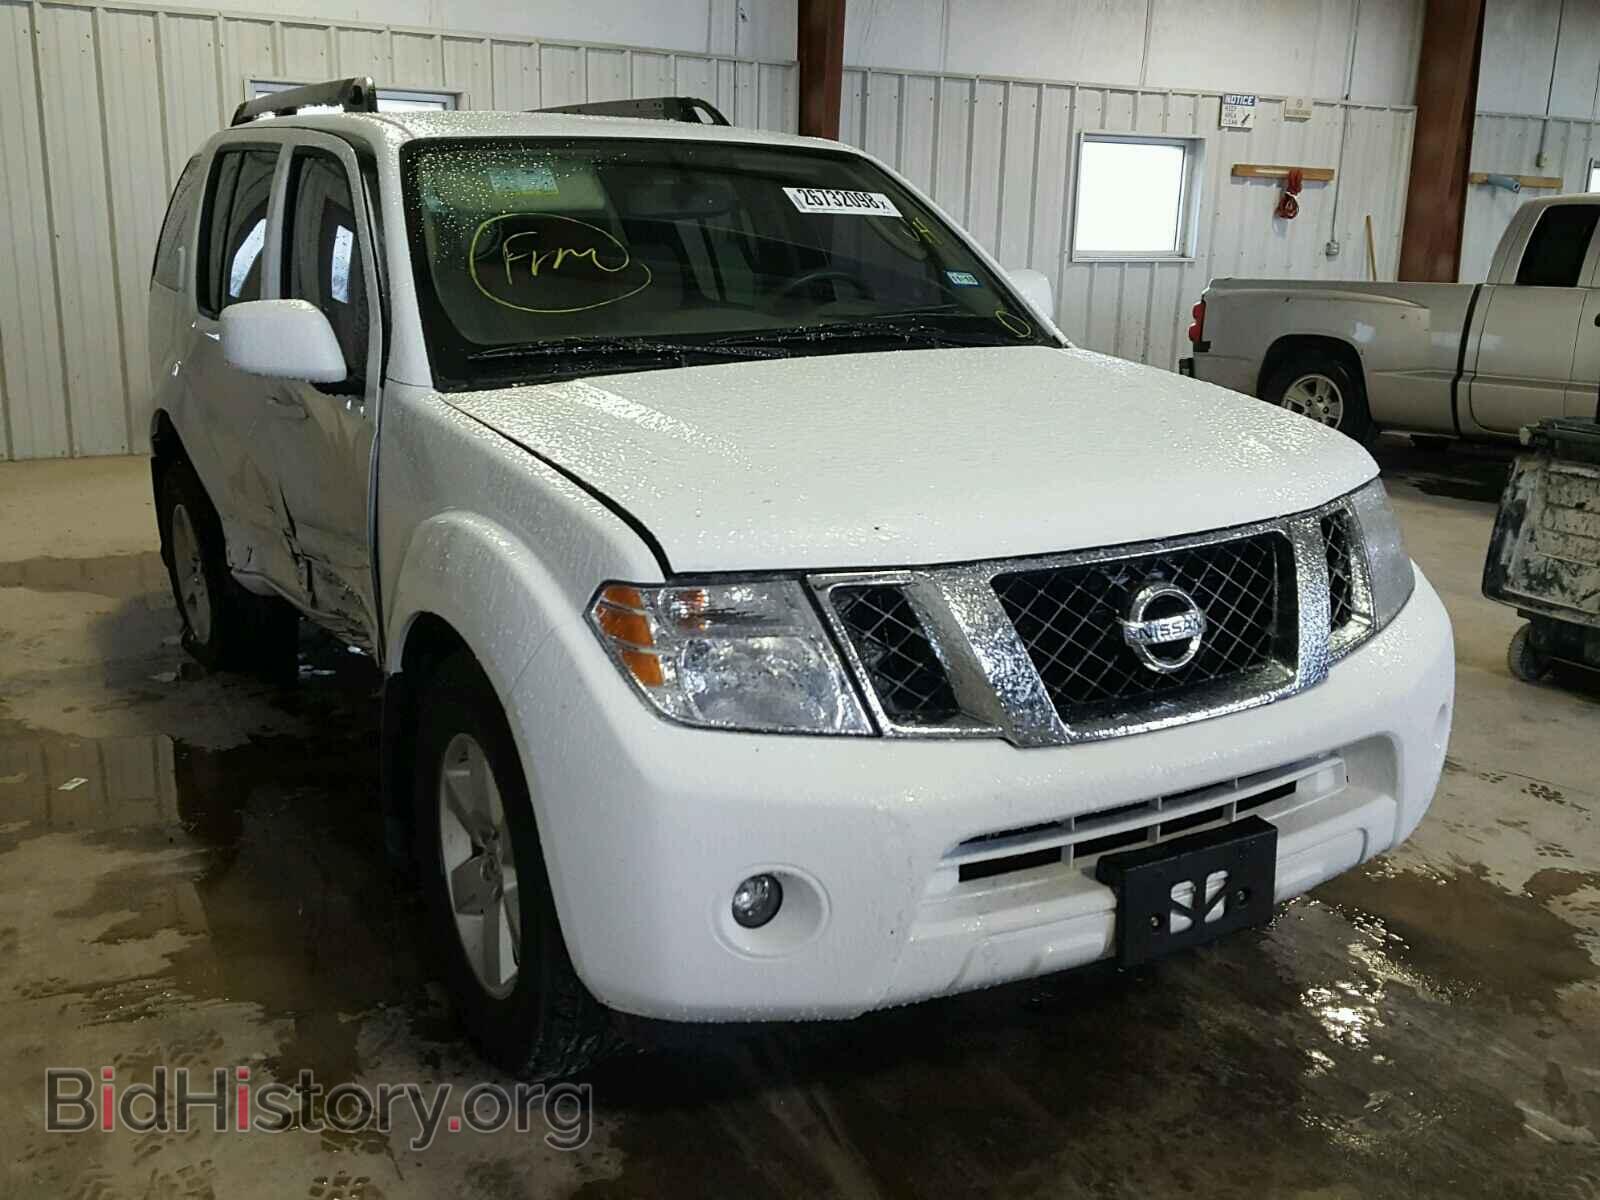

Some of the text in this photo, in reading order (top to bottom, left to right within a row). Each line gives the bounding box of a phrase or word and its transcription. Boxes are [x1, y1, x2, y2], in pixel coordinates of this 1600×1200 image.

[1224, 95, 1254, 105] NOTICE
[797, 188, 880, 209] 26732098
[1138, 613, 1202, 639] NISSAN
